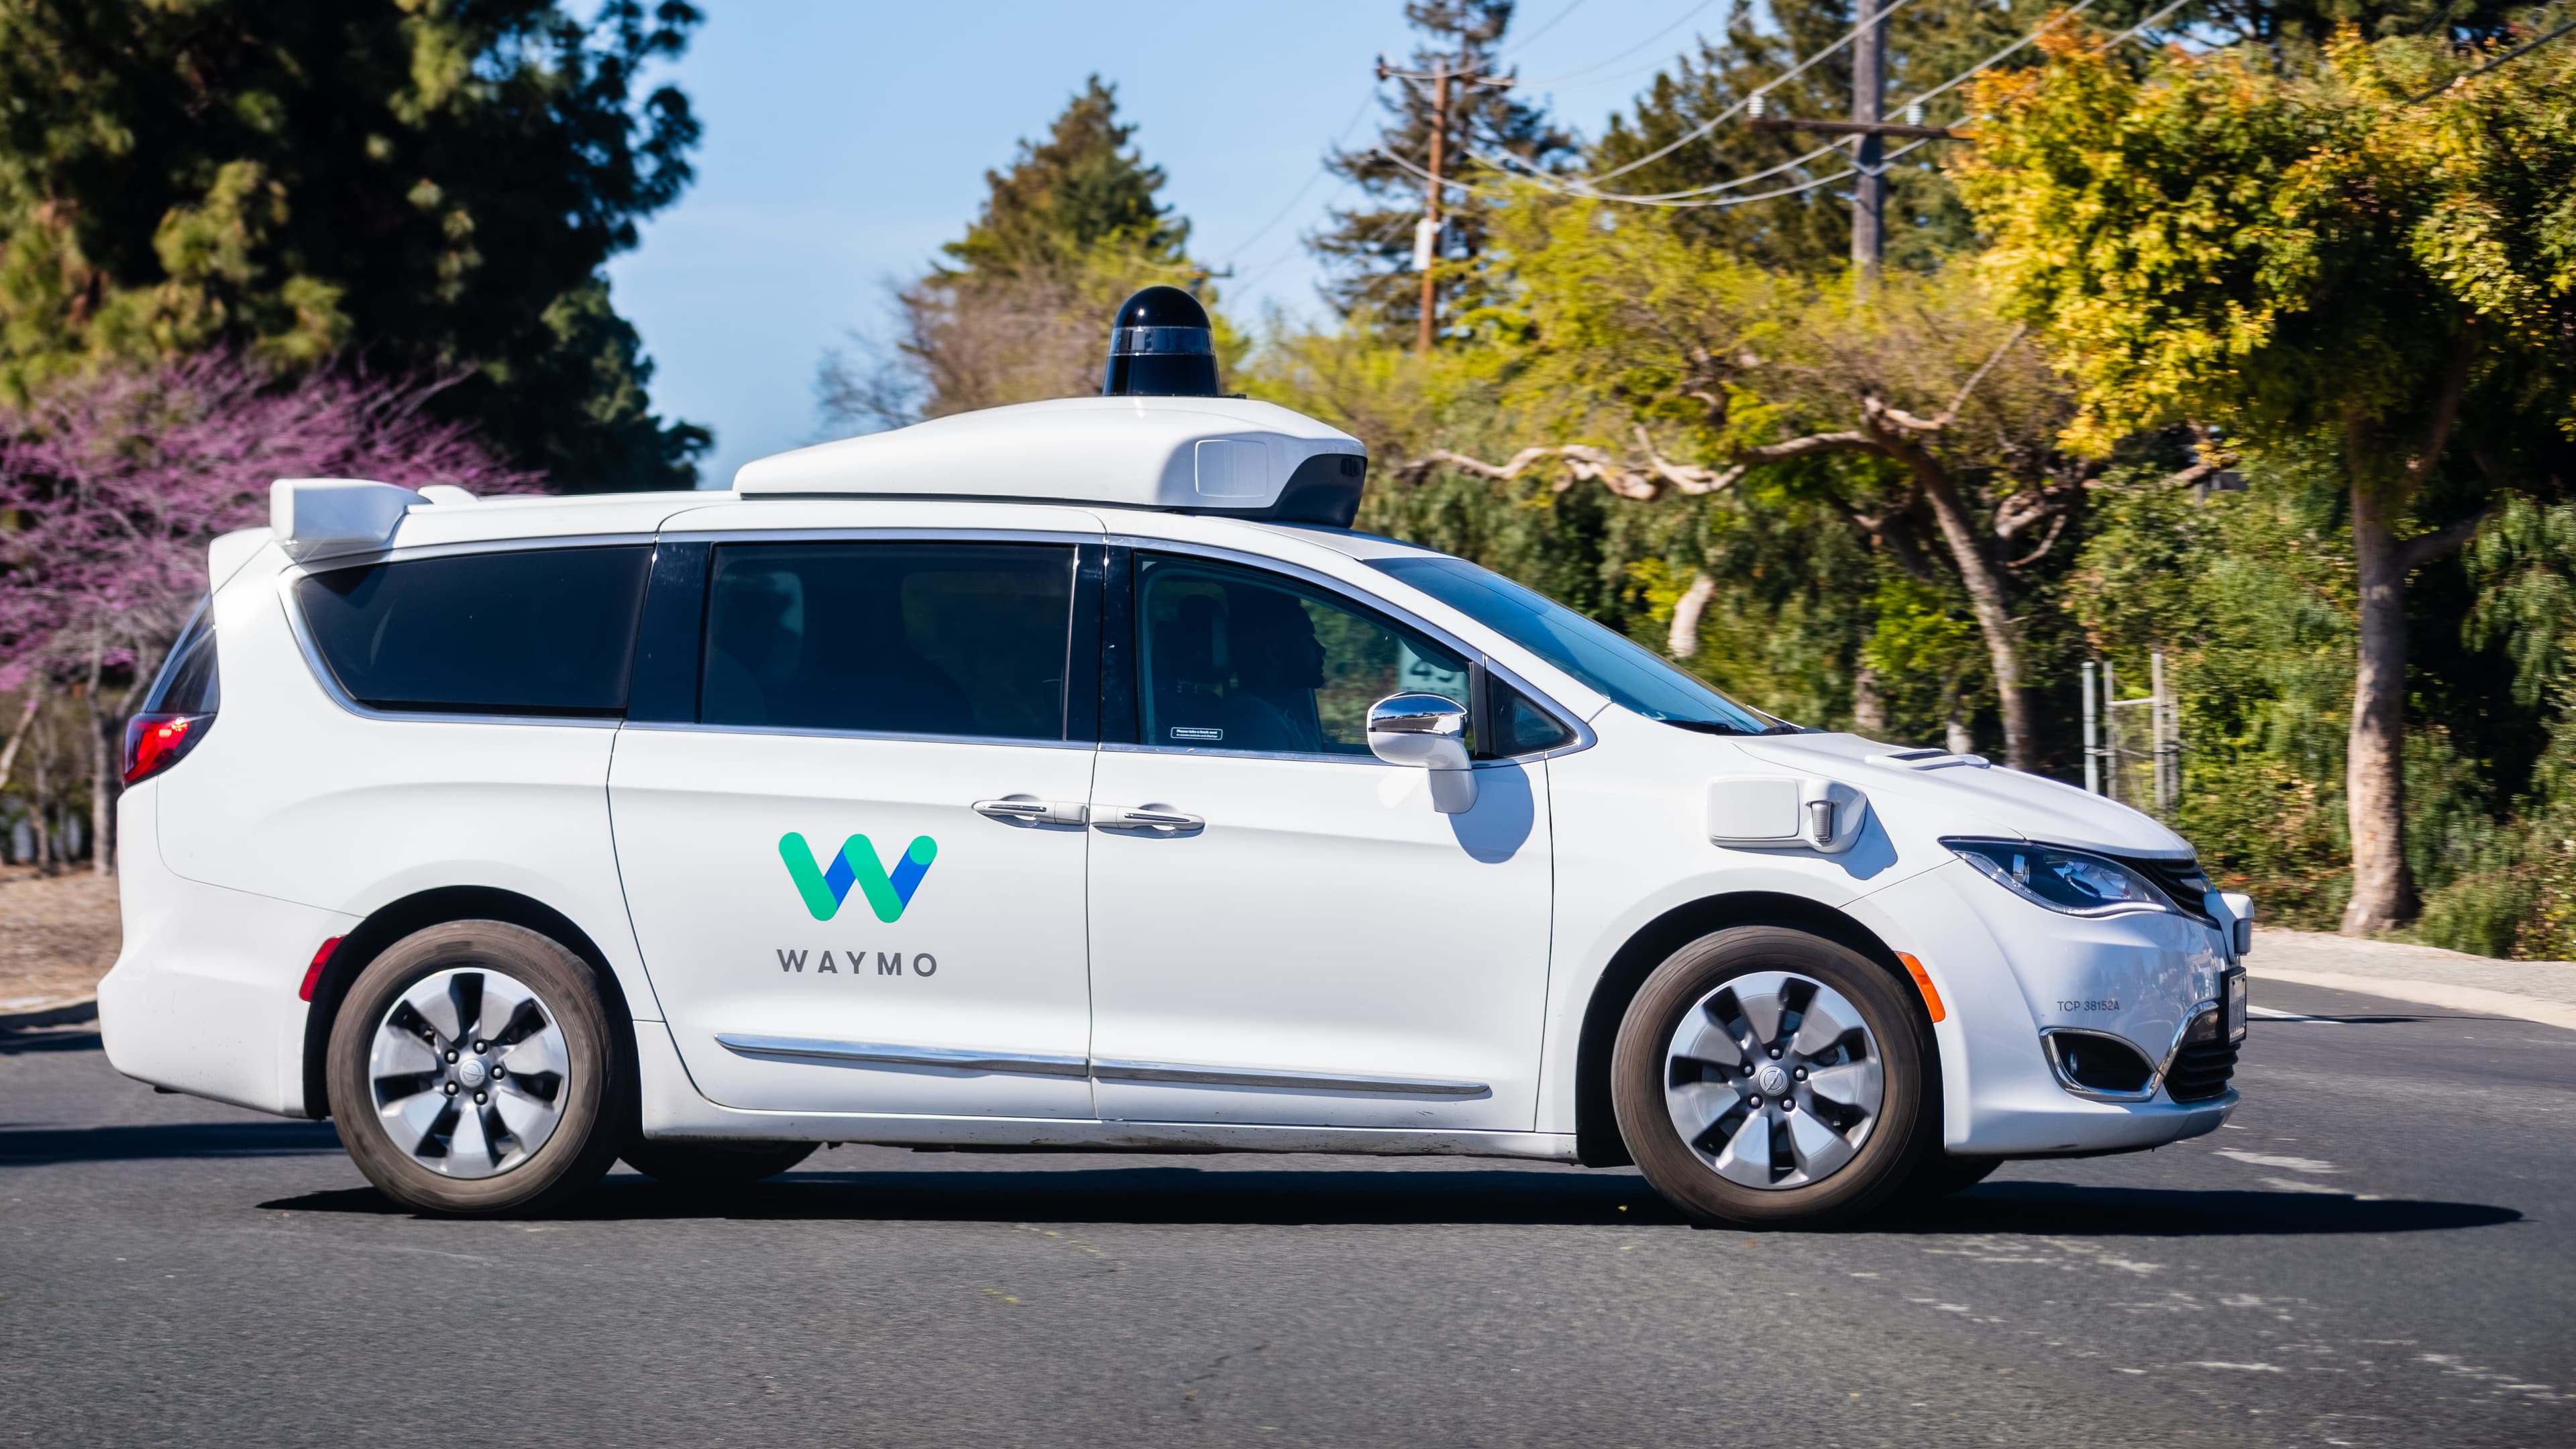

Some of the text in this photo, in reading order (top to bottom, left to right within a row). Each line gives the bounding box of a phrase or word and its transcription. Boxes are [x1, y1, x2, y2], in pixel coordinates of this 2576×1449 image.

[776, 949, 937, 977] WAYMO
[2057, 1000, 2120, 1012] TCP 38152A
